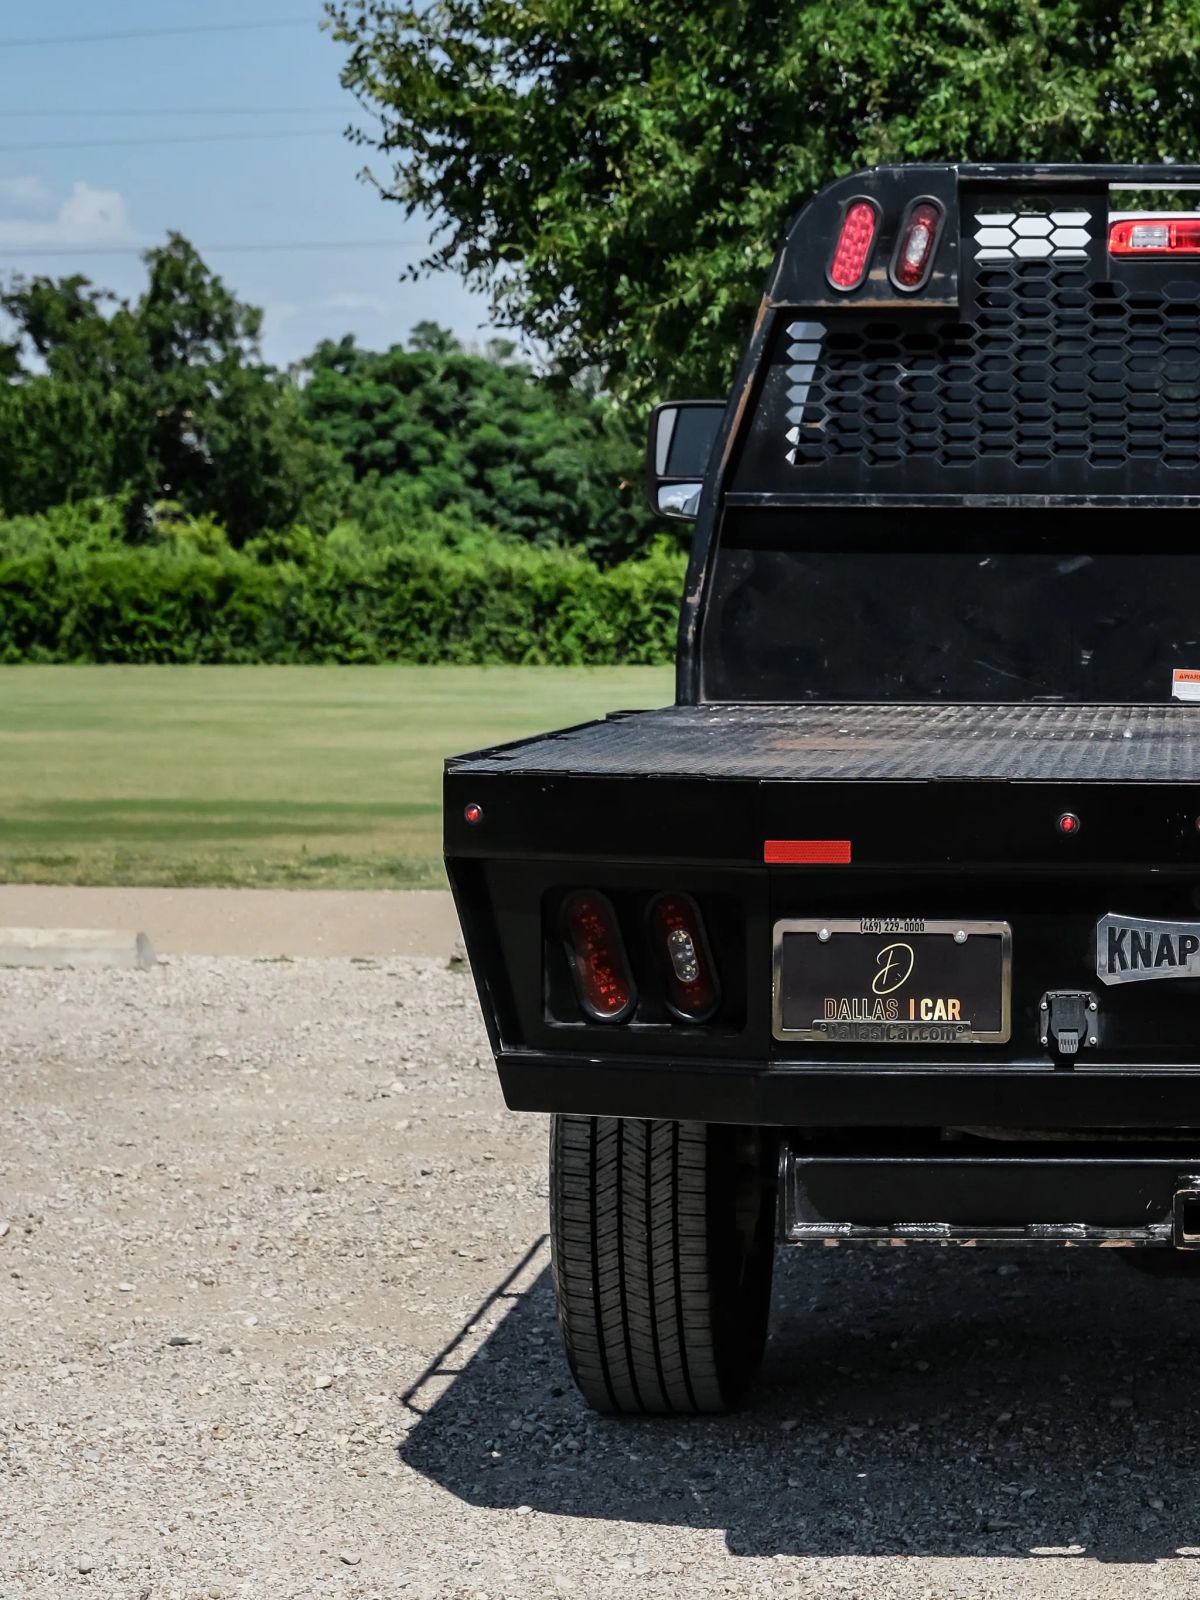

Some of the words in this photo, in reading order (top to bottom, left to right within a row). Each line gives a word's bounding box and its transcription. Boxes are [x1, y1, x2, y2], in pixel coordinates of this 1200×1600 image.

[860, 921, 882, 934] (469)
[884, 921, 925, 932] 229-0000
[824, 998, 898, 1020] DALLAS
[920, 998, 961, 1020] CAR
